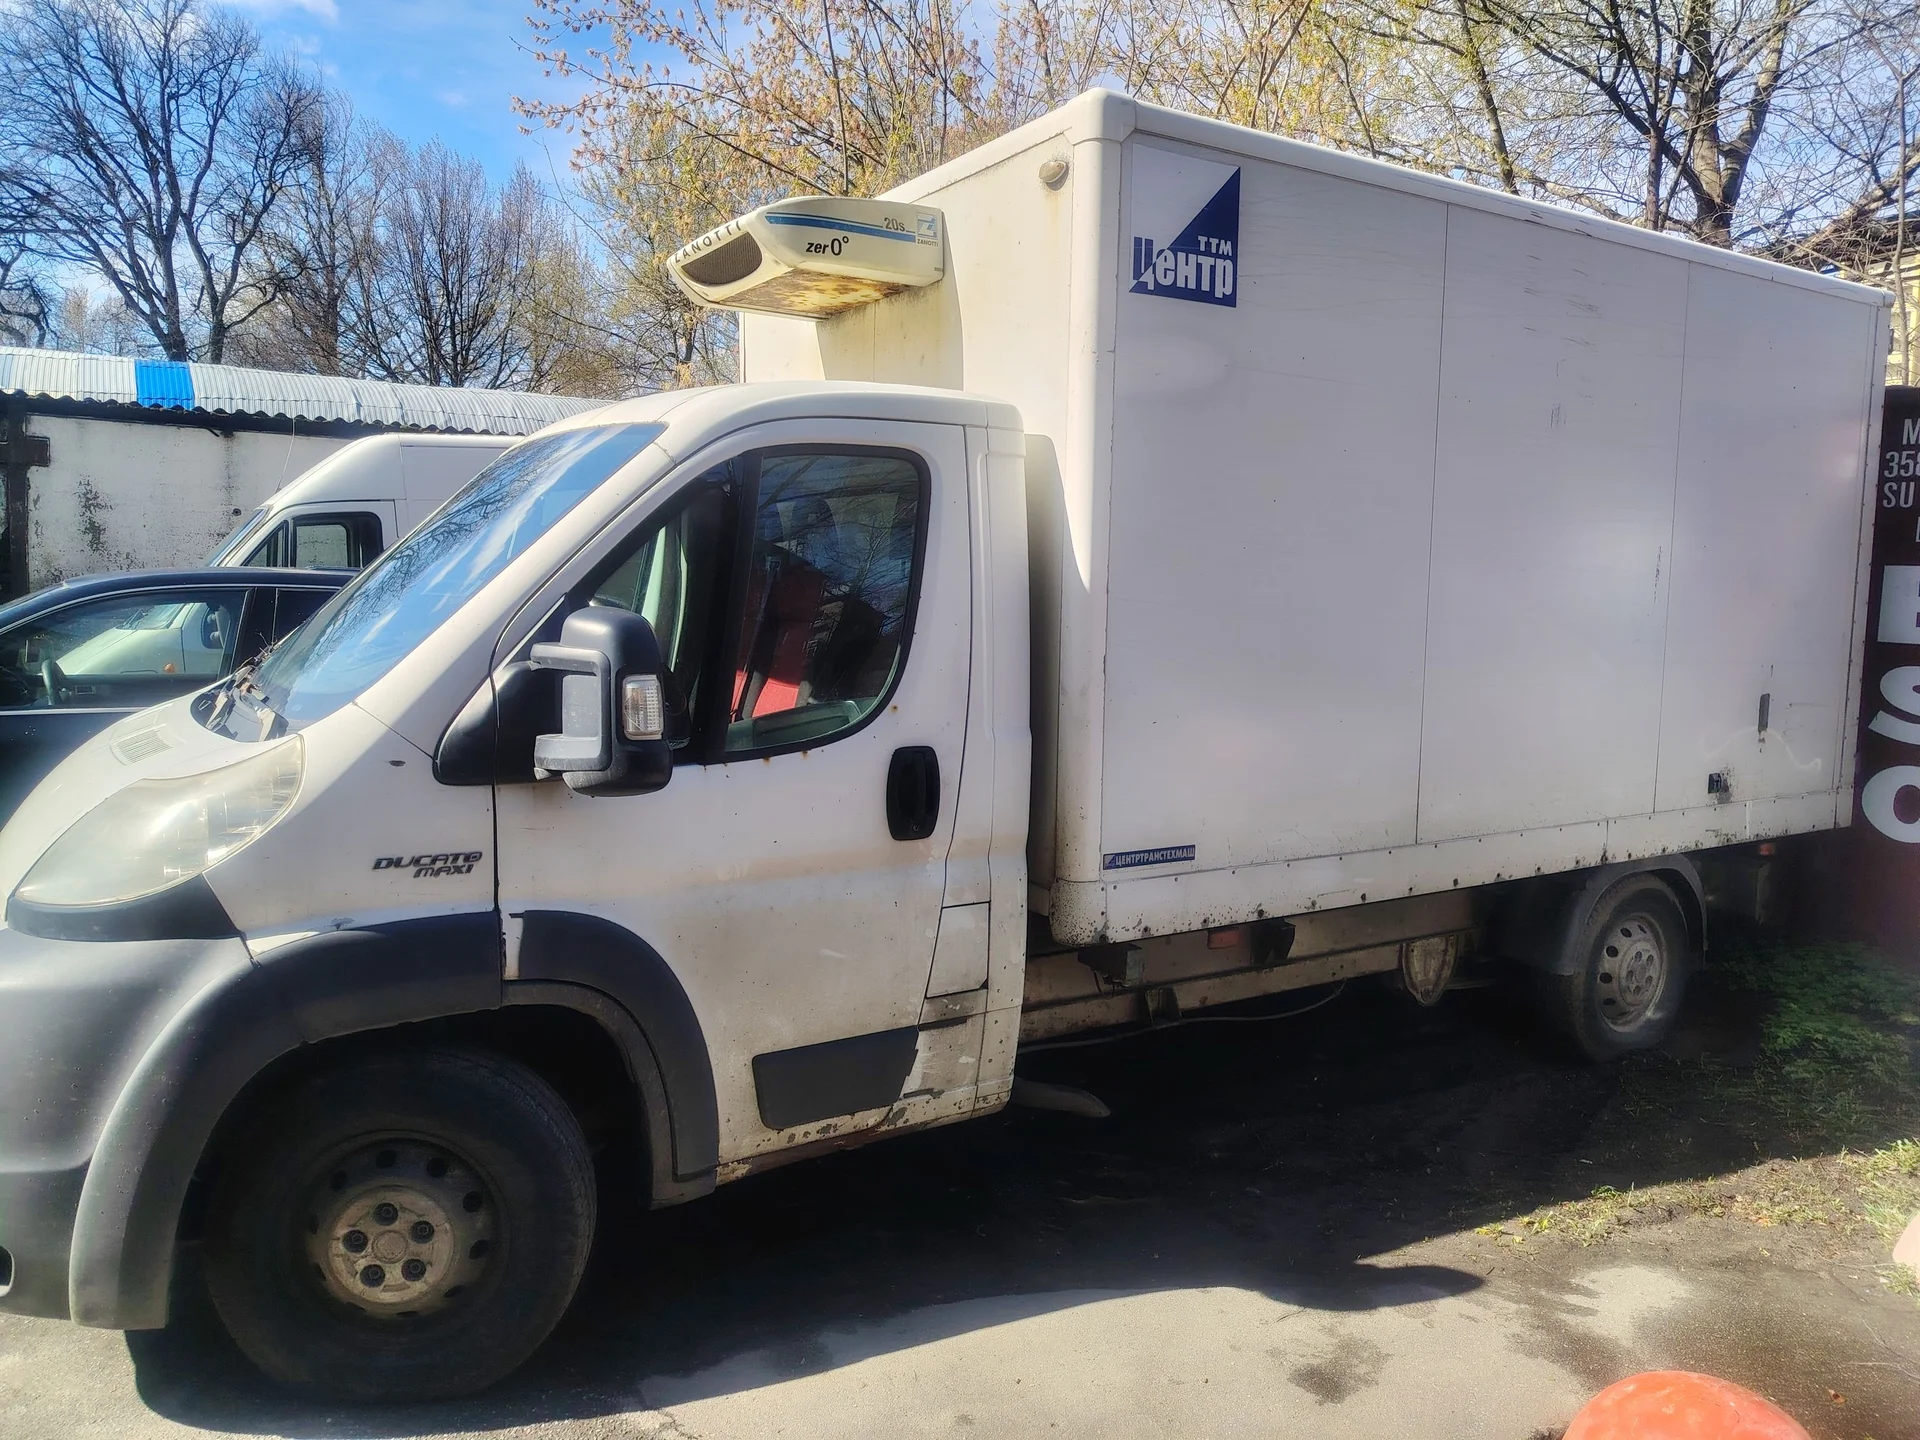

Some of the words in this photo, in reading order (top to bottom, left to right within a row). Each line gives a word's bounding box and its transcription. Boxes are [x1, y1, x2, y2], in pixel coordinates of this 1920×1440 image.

[674, 221, 742, 264] ZANOTTI
[917, 238, 939, 247] ZANOTTI
[1132, 236, 1234, 299] Центр
[1882, 481, 1915, 508] SU
[372, 851, 483, 870] DUCATO
[1115, 847, 1195, 867] ЦЕНТРТРАНСТЕХМАШ
[413, 864, 474, 878] MAXI
